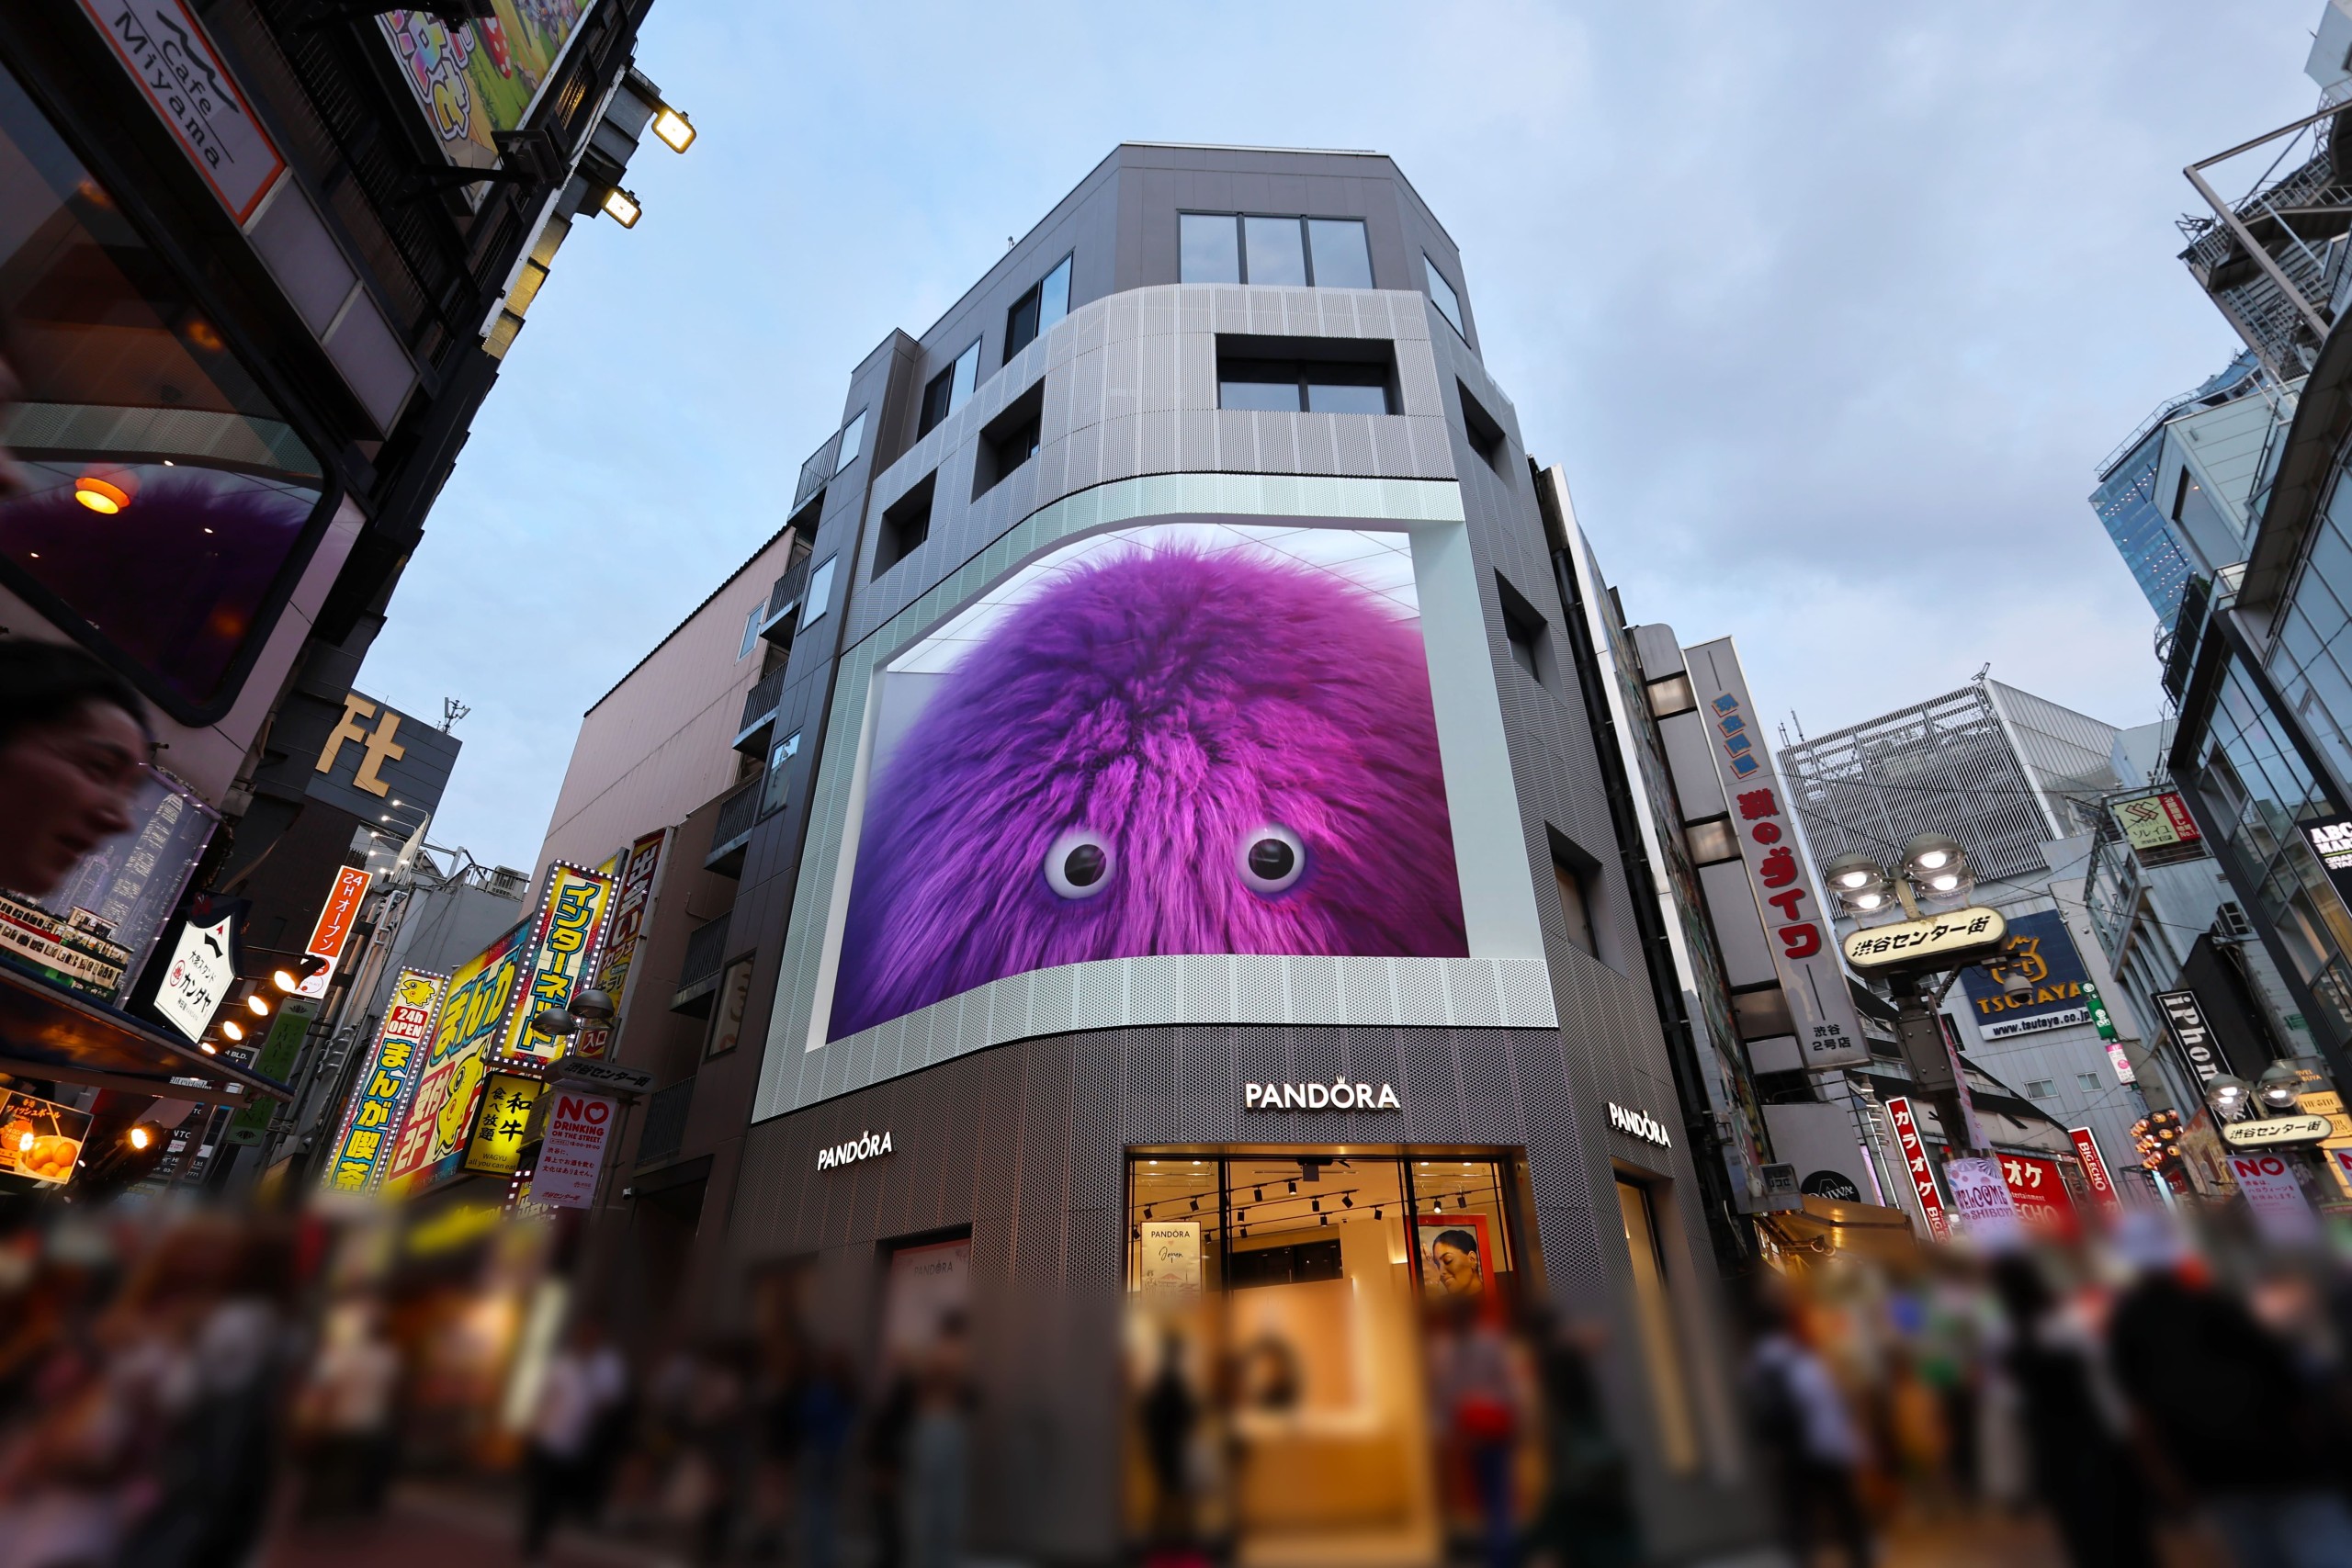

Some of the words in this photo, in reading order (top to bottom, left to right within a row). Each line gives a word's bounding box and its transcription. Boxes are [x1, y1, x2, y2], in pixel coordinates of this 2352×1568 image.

[114, 11, 220, 170] Miyama
[162, 39, 212, 116] Cafe
[2310, 821, 2352, 844] ABC
[611, 844, 659, 949] 出会い
[1851, 916, 1991, 957] 渋谷センター街
[388, 1021, 424, 1037] OPEN
[396, 1007, 424, 1025] 24h
[1993, 1010, 2090, 1036] www.tsutaya.co.jp
[583, 1030, 609, 1051] 入口
[1813, 1023, 1841, 1038] 渋谷
[2163, 995, 2220, 1082] iPhon
[1812, 1036, 1851, 1052] 2号店
[564, 1062, 652, 1088] 渋谷センター街
[1245, 1076, 1400, 1111] PANDORA
[334, 1041, 413, 1191] まんが喫茶
[478, 1087, 507, 1142] 食べ放題
[498, 1091, 533, 1143] 和牛
[556, 1095, 610, 1125] NO
[553, 1120, 605, 1136] DRINKING
[564, 1132, 577, 1140] THE
[578, 1134, 603, 1144] STREET.
[1609, 1101, 1671, 1149] PANDORA
[2229, 1121, 2322, 1140] 渋谷センター街
[395, 1119, 433, 1170] 2F
[482, 1153, 508, 1162] WAGYU
[817, 1130, 893, 1171] PANDORA
[1895, 1111, 1933, 1197] カラオケ
[542, 1165, 594, 1178] 文化はありません。
[2077, 1142, 2094, 1163] BIG
[2088, 1162, 2107, 1191] ECHO
[2233, 1156, 2285, 1178] NO
[2337, 1152, 2352, 1170] N
[2004, 1160, 2042, 1189] オケ
[1955, 1185, 2008, 1211] WELCOME
[1151, 1230, 1190, 1238] PANDORA
[914, 1260, 954, 1277] PANDORA
